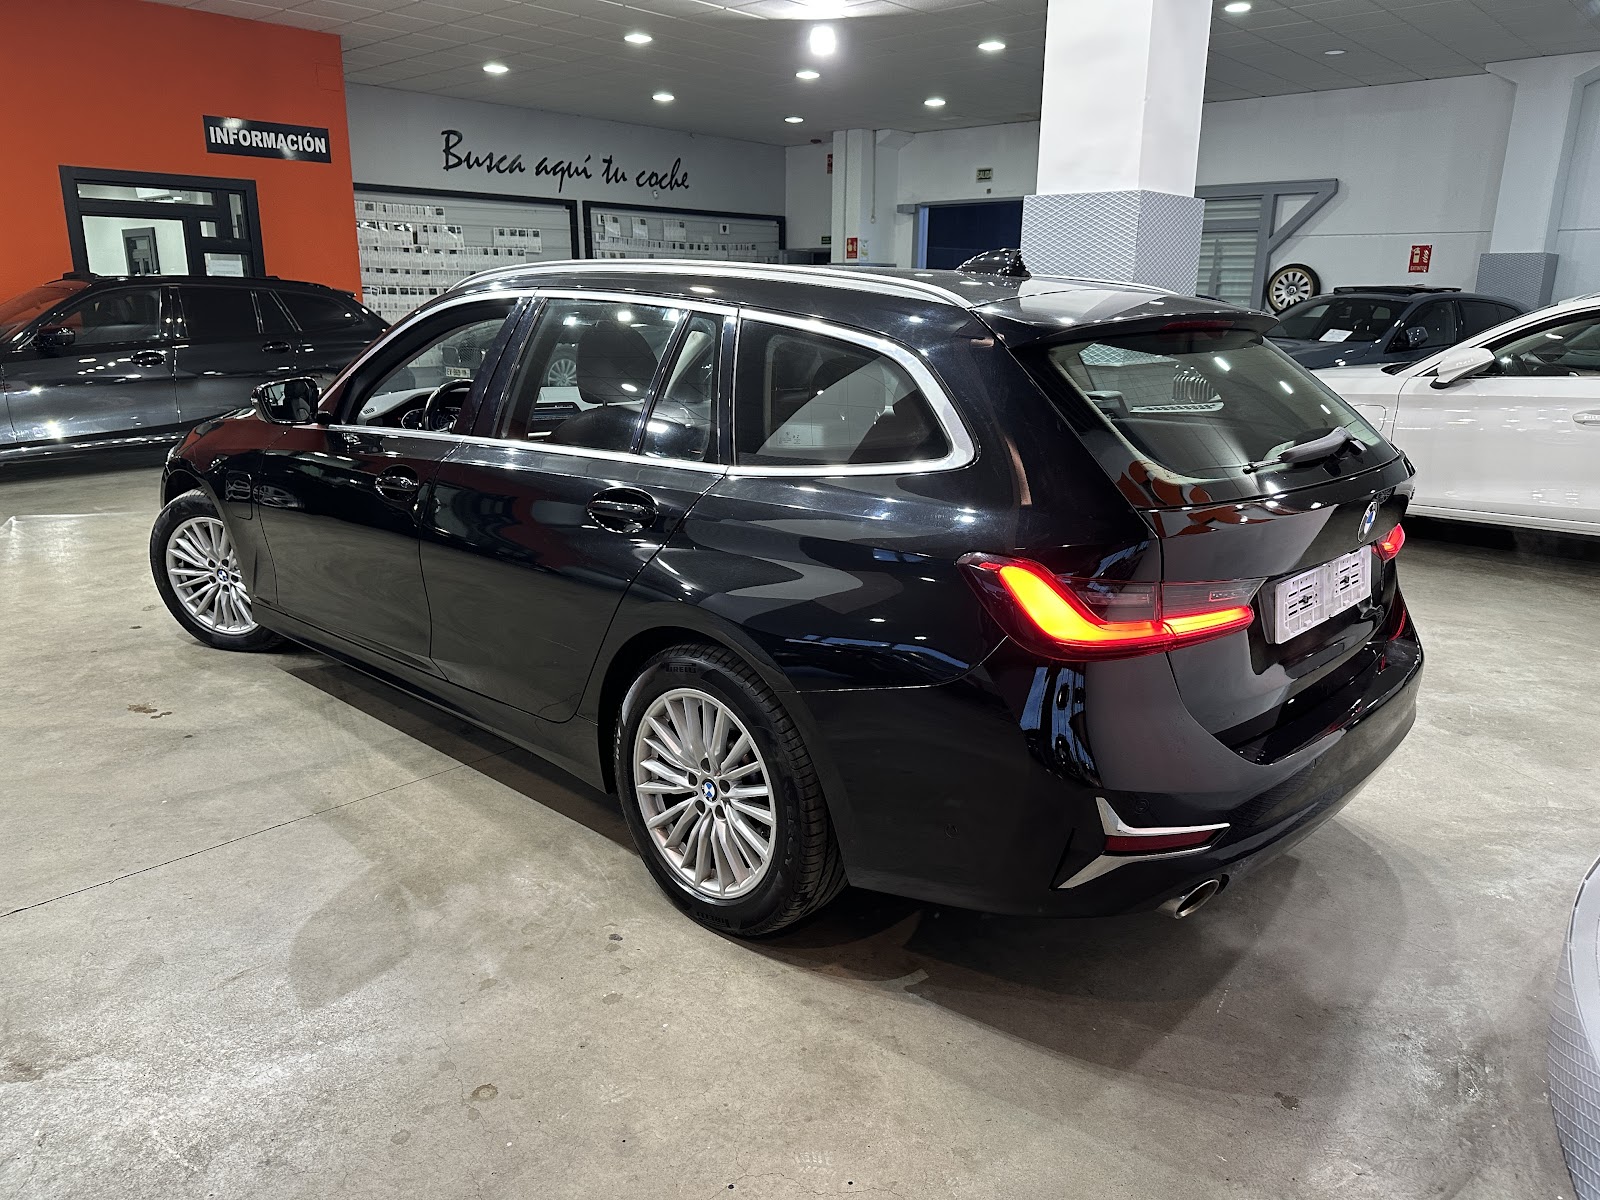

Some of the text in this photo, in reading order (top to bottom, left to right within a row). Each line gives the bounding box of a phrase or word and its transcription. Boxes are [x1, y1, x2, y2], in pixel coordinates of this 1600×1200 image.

[209, 125, 327, 154] INFORMACIÓN
[441, 129, 690, 193] Busca aquí tu coche
[665, 662, 696, 673] PIRELLI
